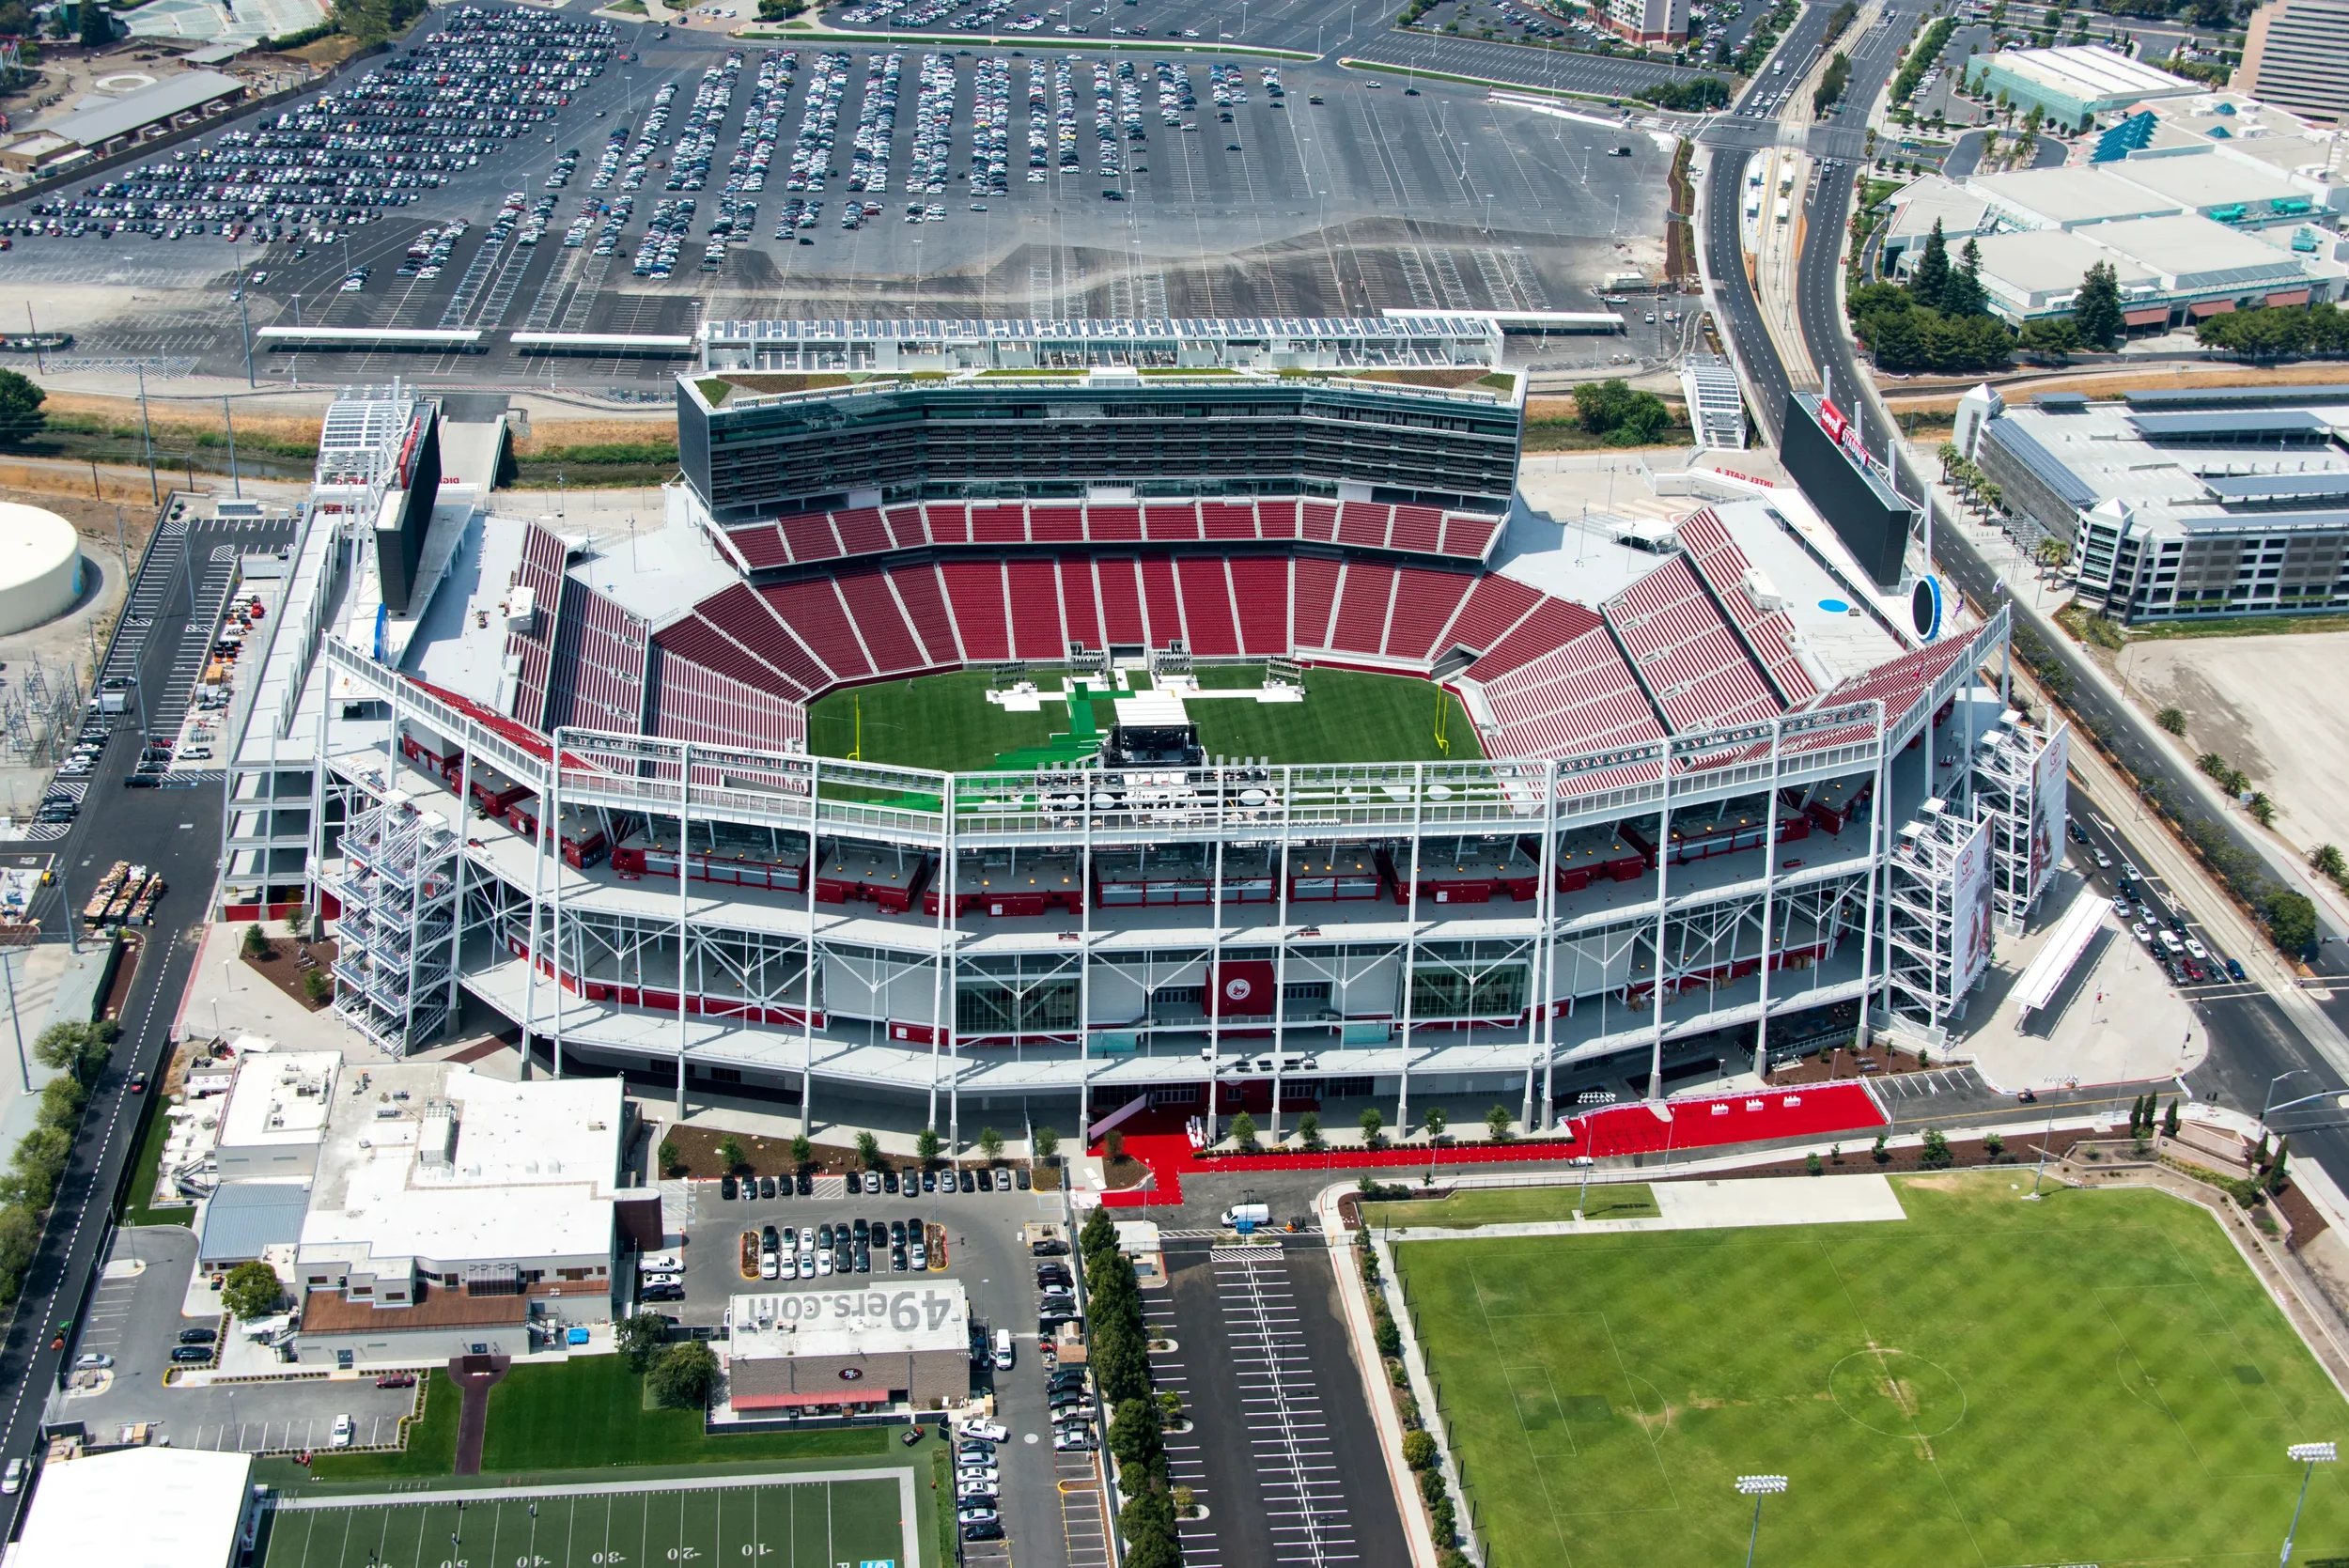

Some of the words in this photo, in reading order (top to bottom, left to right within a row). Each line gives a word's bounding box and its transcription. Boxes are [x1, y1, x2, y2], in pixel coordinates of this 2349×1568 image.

[1842, 427, 1867, 466] STADIUM
[2048, 759, 2062, 778] TOYOTA
[1959, 868, 1975, 890] TOYOTA
[748, 1289, 952, 1332] 49ers.com
[591, 1551, 620, 1564] 30
[666, 1546, 694, 1560] 20
[741, 1544, 767, 1557] 10
[516, 1555, 545, 1568] 40
